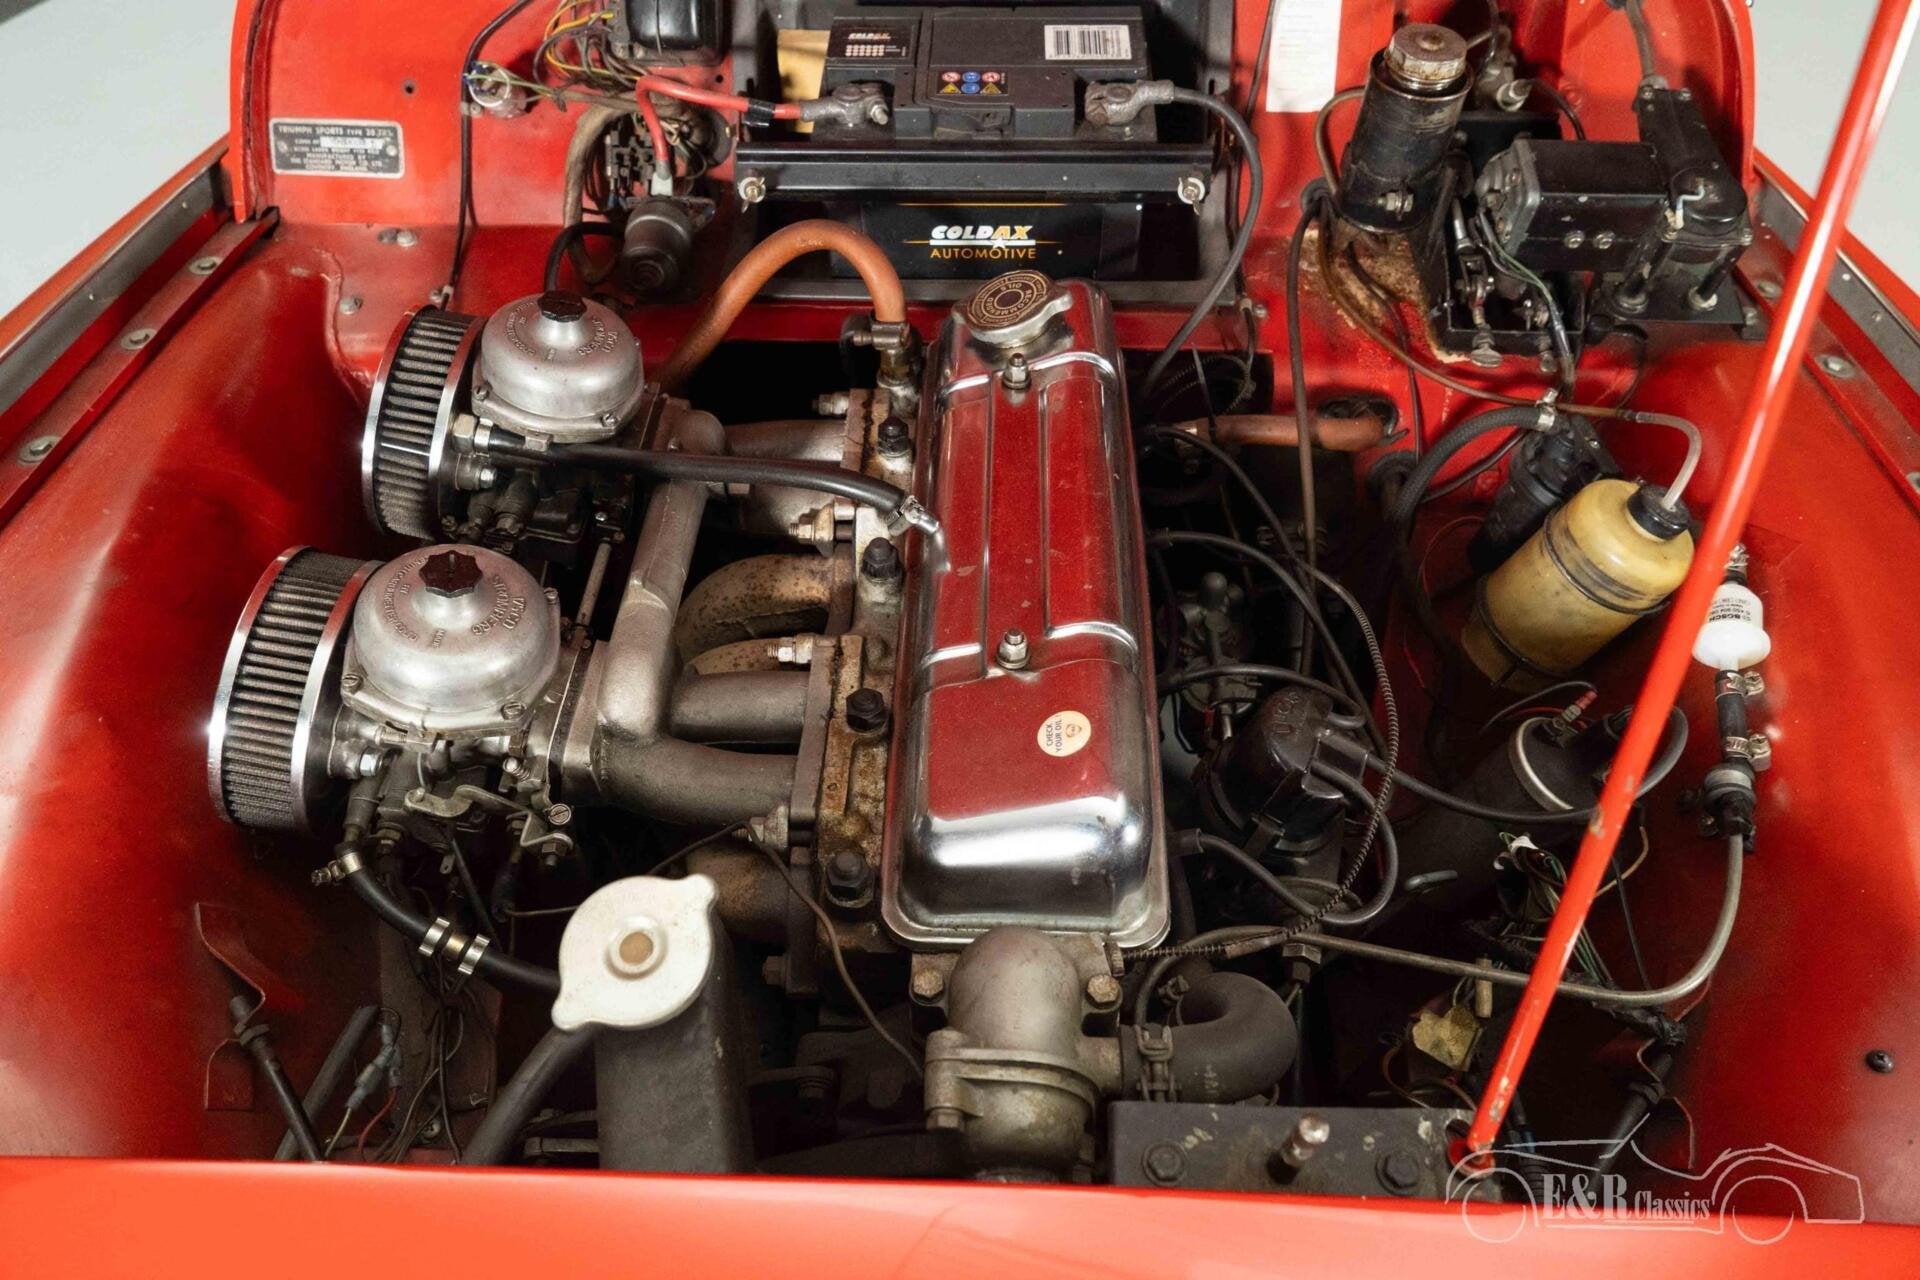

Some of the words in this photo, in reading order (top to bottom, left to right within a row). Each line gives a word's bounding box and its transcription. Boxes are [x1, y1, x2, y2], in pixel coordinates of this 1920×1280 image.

[278, 125, 313, 134] TRIUMPH
[315, 126, 344, 135] SPORTS
[346, 128, 363, 136] TYPE
[931, 225, 1033, 239] COLDAX
[930, 248, 1036, 259] AUTOMOTIVE
[1709, 614, 1740, 622] BOSCH
[1046, 723, 1054, 747] CHECK
[1055, 732, 1063, 753] YOUR
